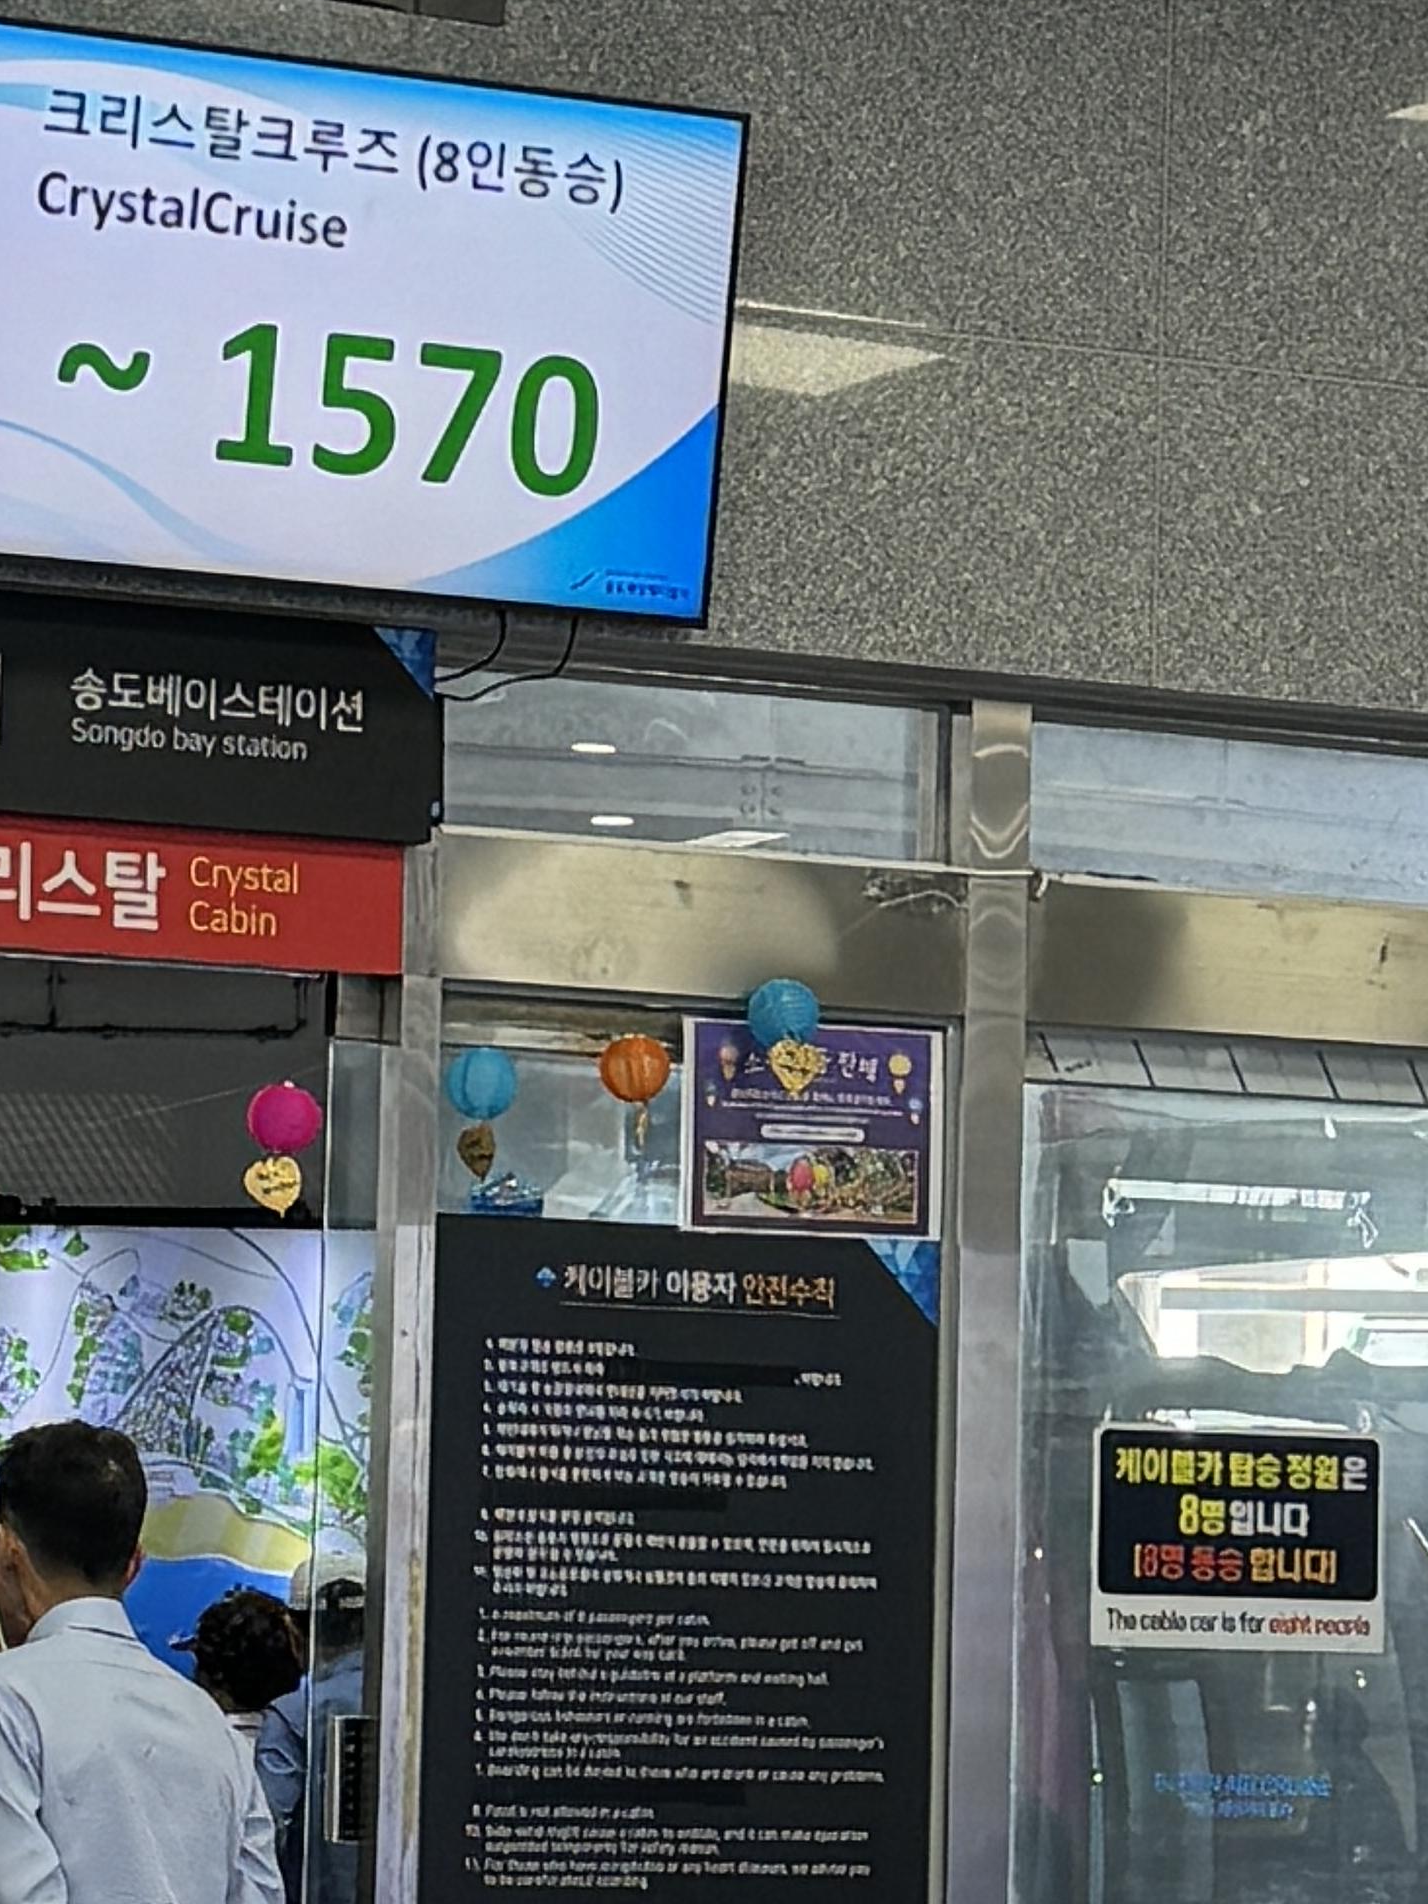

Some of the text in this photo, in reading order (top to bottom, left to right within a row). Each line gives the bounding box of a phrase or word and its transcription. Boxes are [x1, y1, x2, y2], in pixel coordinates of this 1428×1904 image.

[43, 86, 625, 216] 크리스탈크루즈 (8인동승)
[35, 171, 347, 253] CrystalCruise
[213, 322, 600, 498] 1570
[68, 668, 365, 734] 송도베이스테이션
[71, 715, 308, 762] Songdo bay station
[188, 855, 299, 903] Crystal
[188, 898, 277, 938] Cabin
[563, 1264, 660, 1299] 케이블카
[665, 1268, 737, 1305] 이용자
[1116, 1448, 1368, 1492] 케이블카 탑승 정원은
[1179, 1493, 1310, 1537] 8명입니다
[1107, 1607, 1137, 1632] The
[1140, 1609, 1187, 1633] cable
[1190, 1615, 1217, 1633] car
[1221, 1612, 1235, 1633] is
[1240, 1612, 1265, 1634] for
